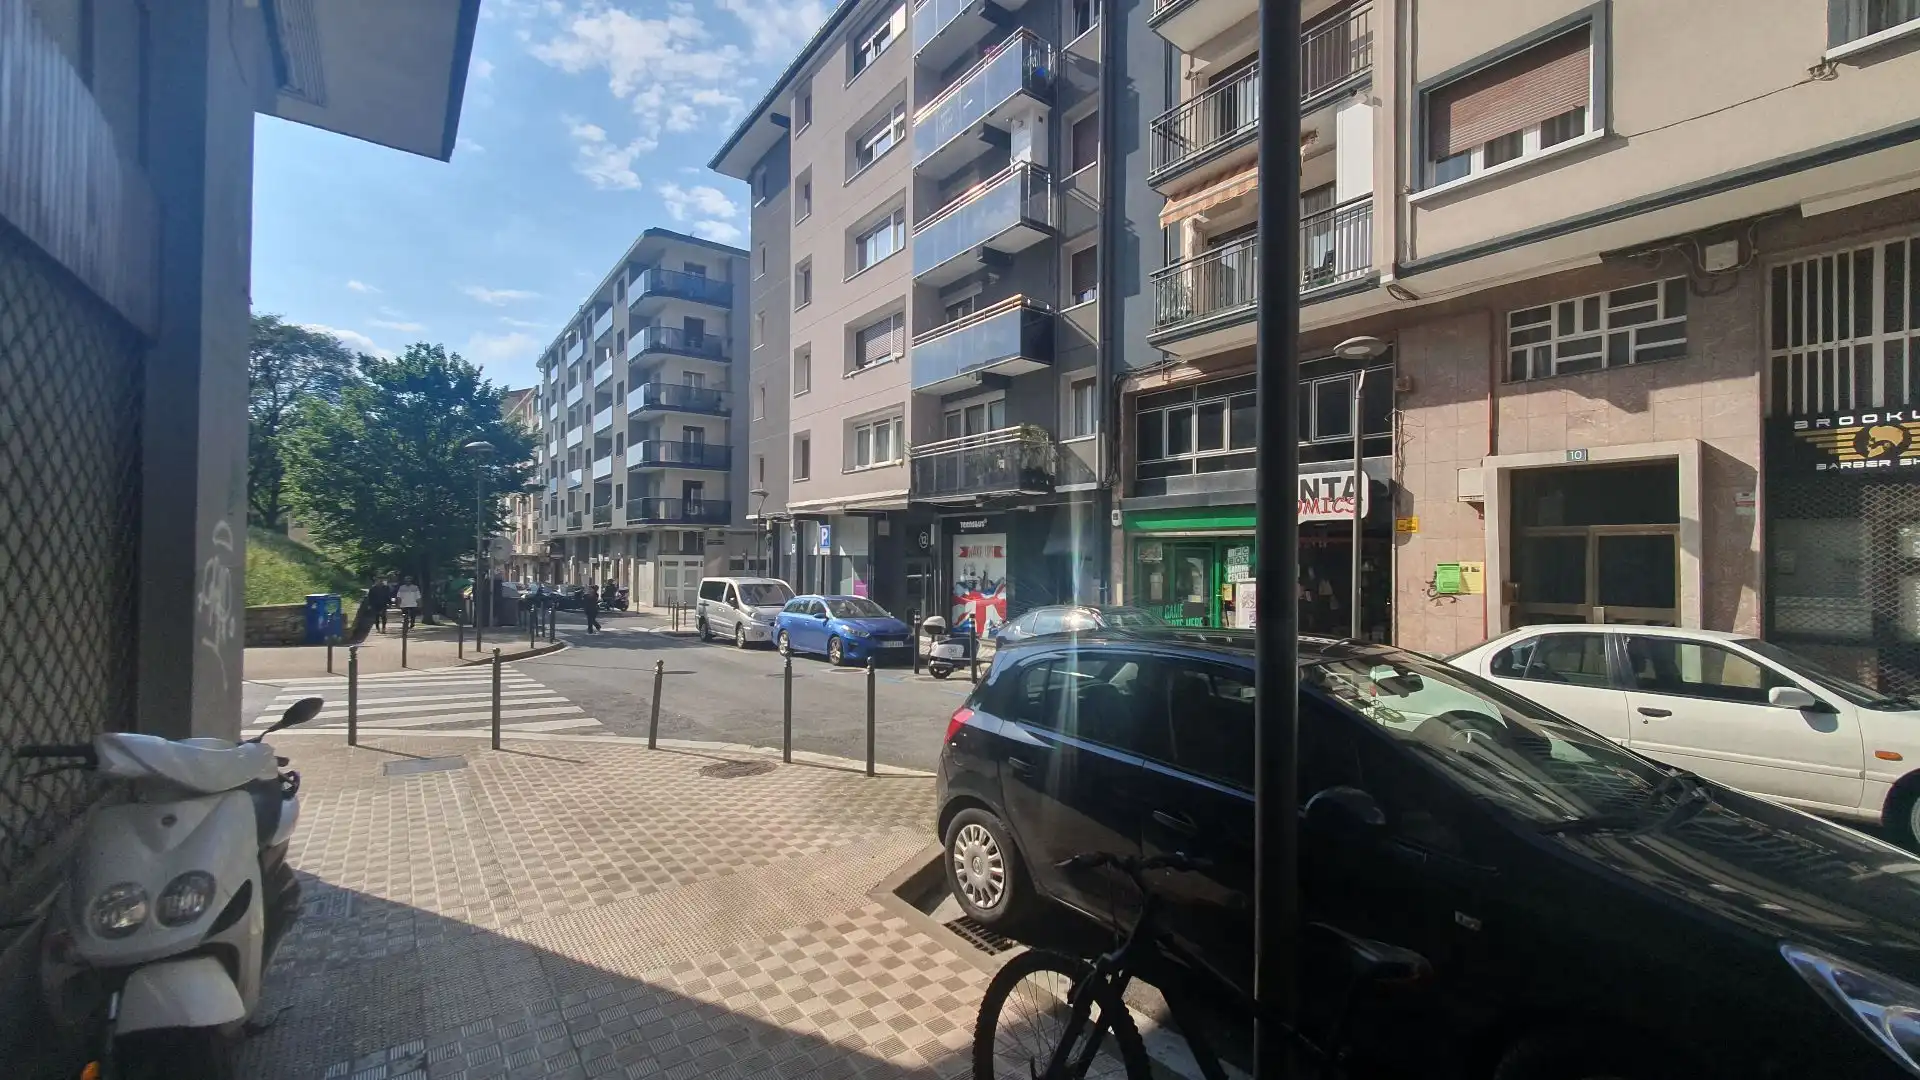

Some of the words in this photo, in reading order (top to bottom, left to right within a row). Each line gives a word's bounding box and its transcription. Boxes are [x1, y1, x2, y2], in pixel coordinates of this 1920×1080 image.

[1570, 450, 1582, 460] 10
[1816, 459, 1891, 471] BARBER
[821, 527, 829, 546] P
[1164, 603, 1184, 619] GAME
